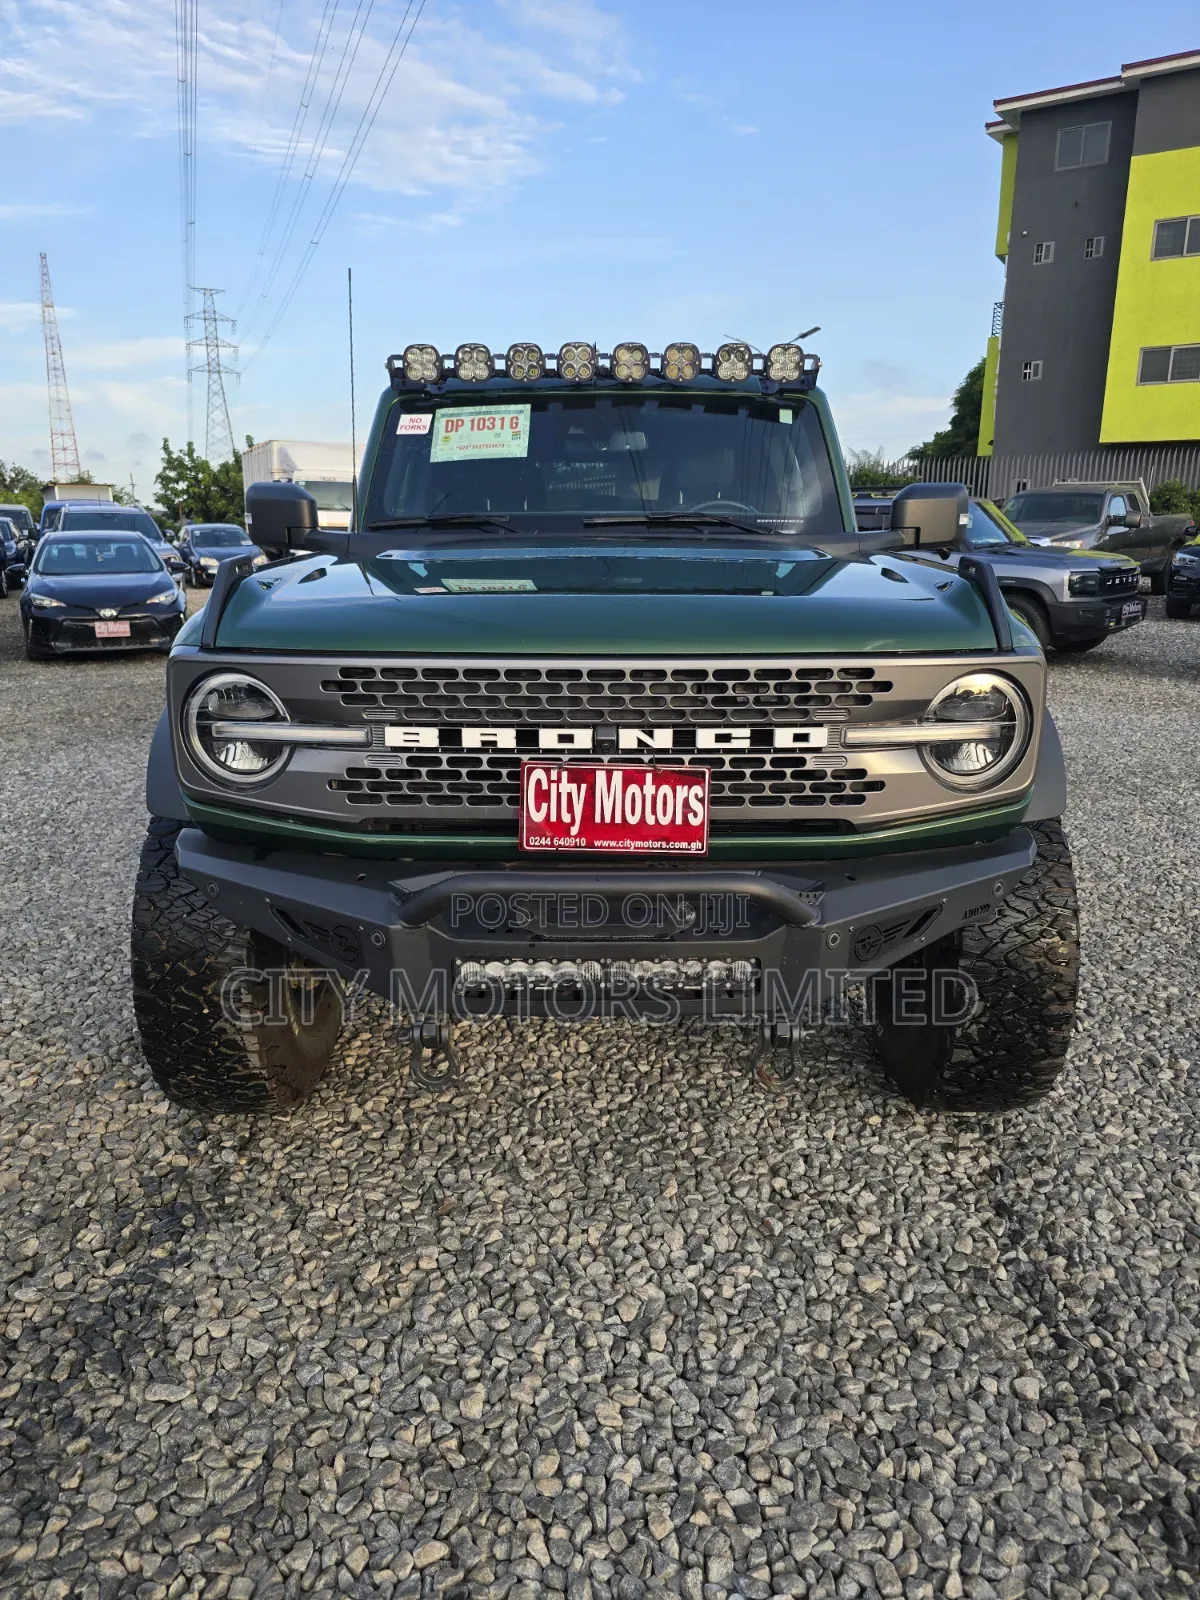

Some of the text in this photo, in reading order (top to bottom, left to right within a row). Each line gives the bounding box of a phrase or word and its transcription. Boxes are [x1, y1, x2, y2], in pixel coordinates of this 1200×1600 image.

[445, 416, 519, 433] DP 1031 G
[385, 726, 828, 750] BRONCO
[527, 768, 704, 836] City Motors
[529, 836, 702, 851] 0244 640910 www.citymotors.com.gh
